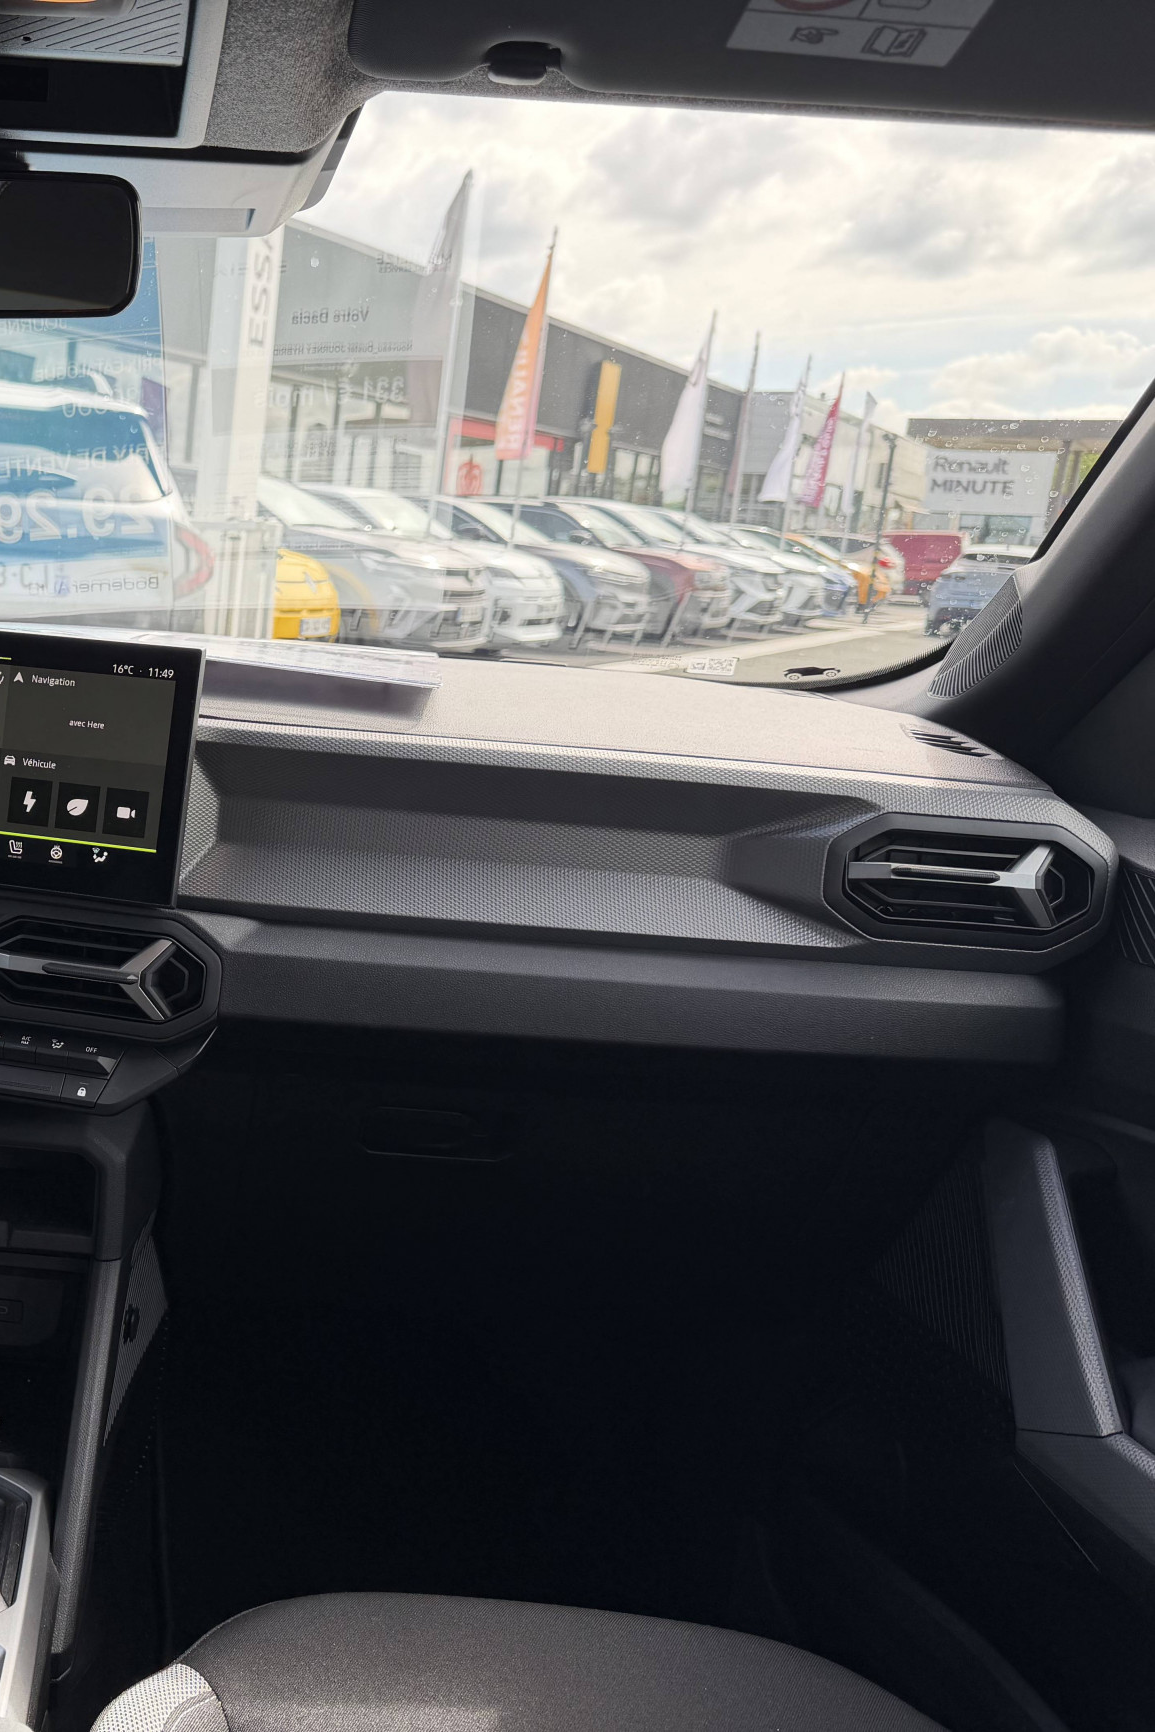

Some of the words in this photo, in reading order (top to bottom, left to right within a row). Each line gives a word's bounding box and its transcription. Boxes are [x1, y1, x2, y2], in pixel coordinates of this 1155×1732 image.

[249, 236, 273, 347] ESS
[932, 455, 1010, 475] Renault
[929, 478, 1015, 496] MINUTE
[112, 663, 135, 676] 16°C
[148, 666, 175, 680] 11:49
[31, 674, 76, 688] Navigation
[69, 719, 85, 729] avec
[85, 718, 105, 731] Here
[22, 756, 57, 771] Véhicule
